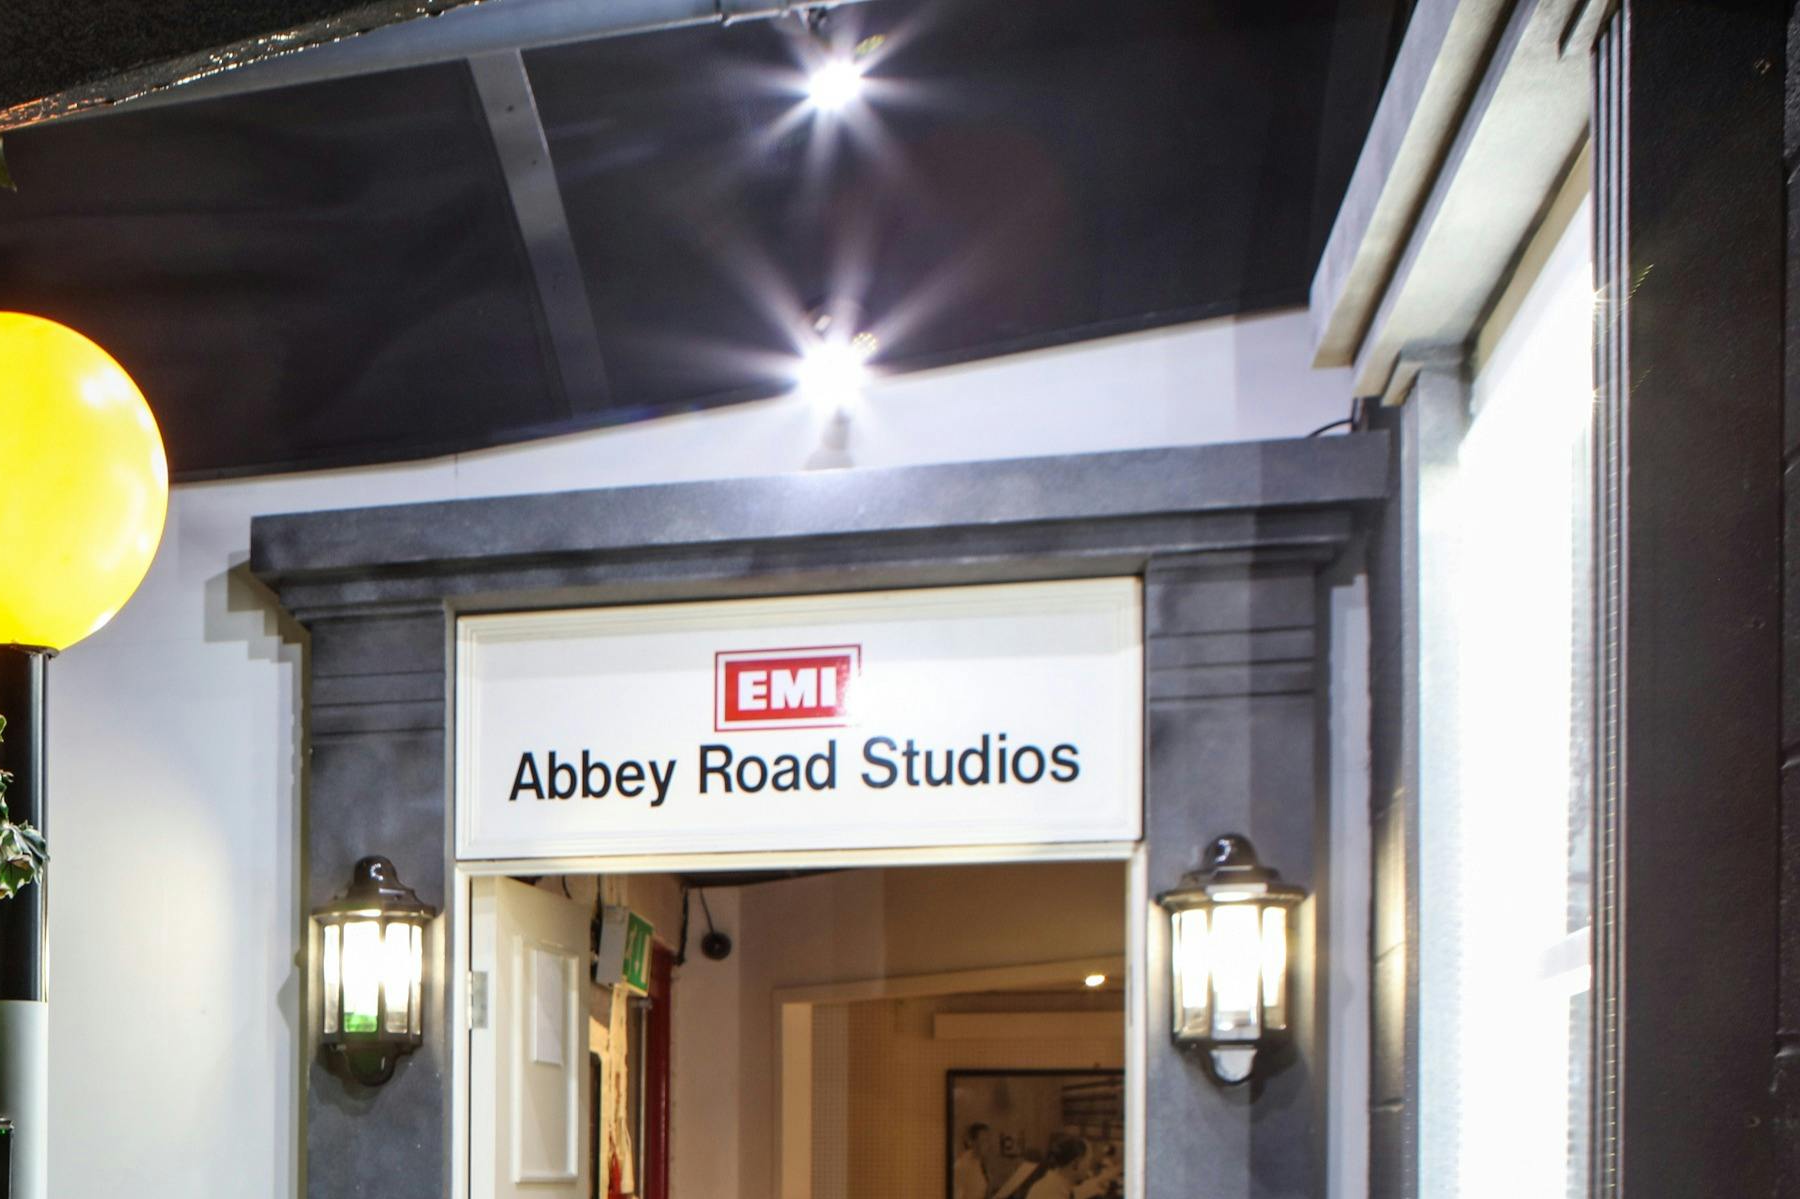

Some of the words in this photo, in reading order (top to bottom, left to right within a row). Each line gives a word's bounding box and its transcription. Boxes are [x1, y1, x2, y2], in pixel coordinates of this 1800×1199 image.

[737, 668, 837, 712] EMI
[509, 750, 677, 807] Abbey
[698, 740, 837, 795] Road
[861, 733, 1081, 790] Studios
